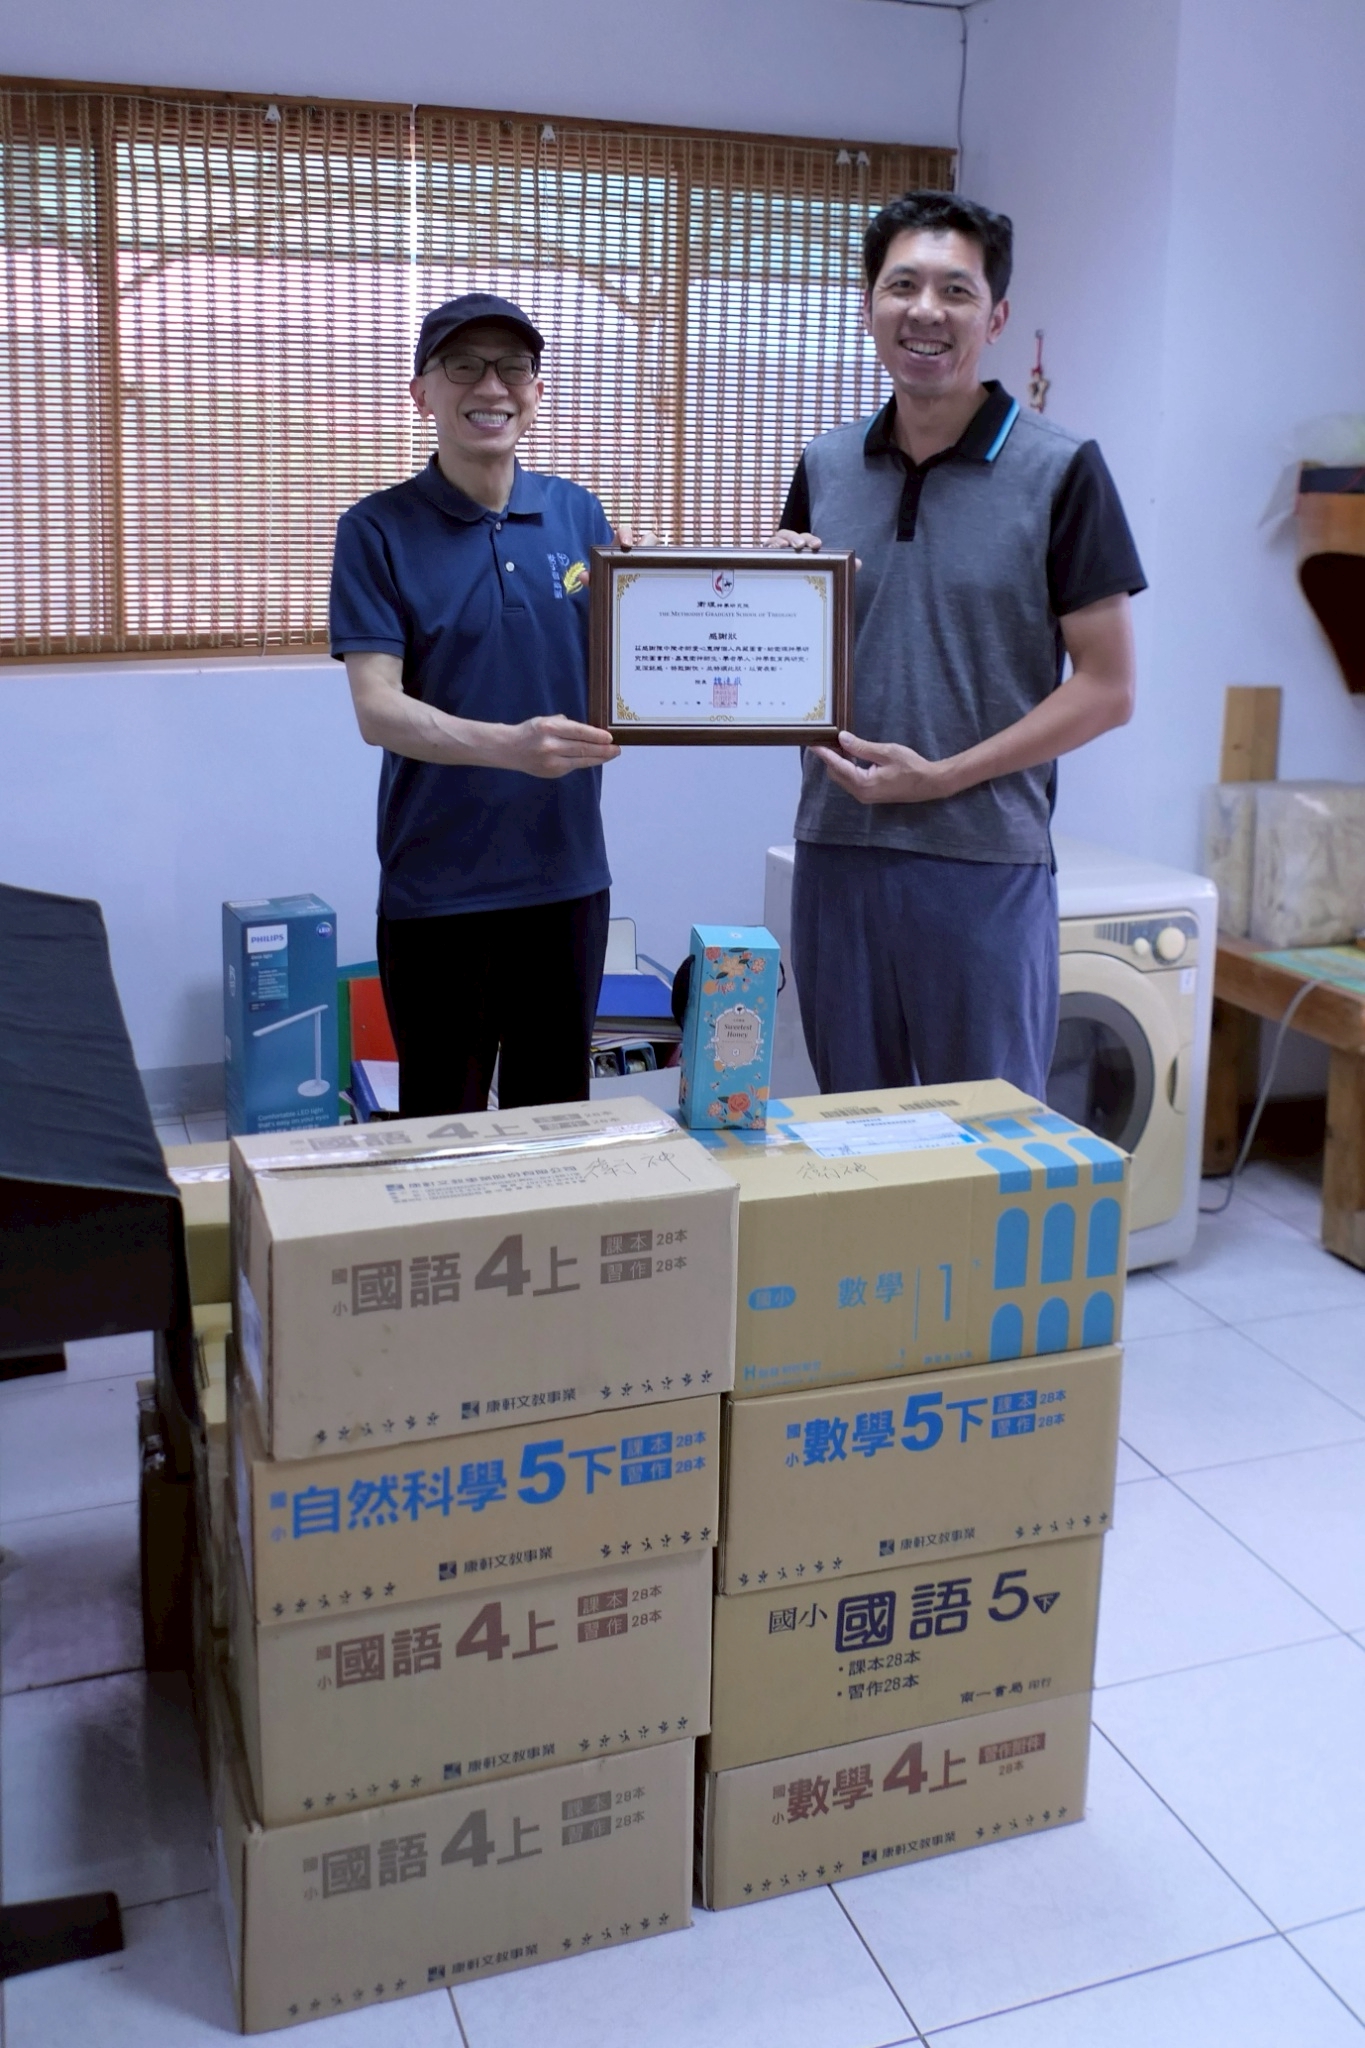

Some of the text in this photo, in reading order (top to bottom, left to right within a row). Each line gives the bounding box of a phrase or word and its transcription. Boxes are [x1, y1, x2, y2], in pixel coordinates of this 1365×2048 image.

[709, 632, 737, 640] 感謝狀
[251, 934, 284, 943] PHILIPS
[318, 926, 331, 934] LED
[297, 1108, 309, 1116] LED
[310, 1107, 324, 1115] light
[656, 1229, 688, 1247] 28本
[351, 1233, 580, 1316] 國語4上
[605, 1256, 688, 1282] 習作 28本
[837, 1271, 904, 1309] 數學
[938, 1264, 953, 1322] 1
[486, 1387, 576, 1414] 康軒文教事業
[1039, 1390, 1067, 1405] 28本
[803, 1391, 988, 1467] 數學5下
[1038, 1412, 1066, 1428] 28本
[624, 1431, 707, 1459] 課本 28本
[624, 1456, 707, 1485] 習作 28本
[291, 1438, 617, 1540] 自然科學5下
[900, 1527, 976, 1552] 康軒文教事業
[464, 1546, 553, 1575] 康軒文教事業
[631, 1584, 663, 1602] 28本
[582, 1609, 663, 1641] 習作 28本
[768, 1603, 827, 1634] 國小
[335, 1601, 558, 1688] 國語4上
[849, 1650, 921, 1677] 課本28本
[849, 1673, 920, 1700] 習作28本
[960, 1681, 1023, 1704] 南一書局
[468, 1742, 556, 1773] 康軒文教事業
[614, 1786, 646, 1805] 28本
[787, 1741, 968, 1824] 數學4上
[614, 1810, 646, 1830] 28本
[322, 1809, 543, 1899] 國語4上
[451, 1943, 539, 1976] 康軒文教事業
